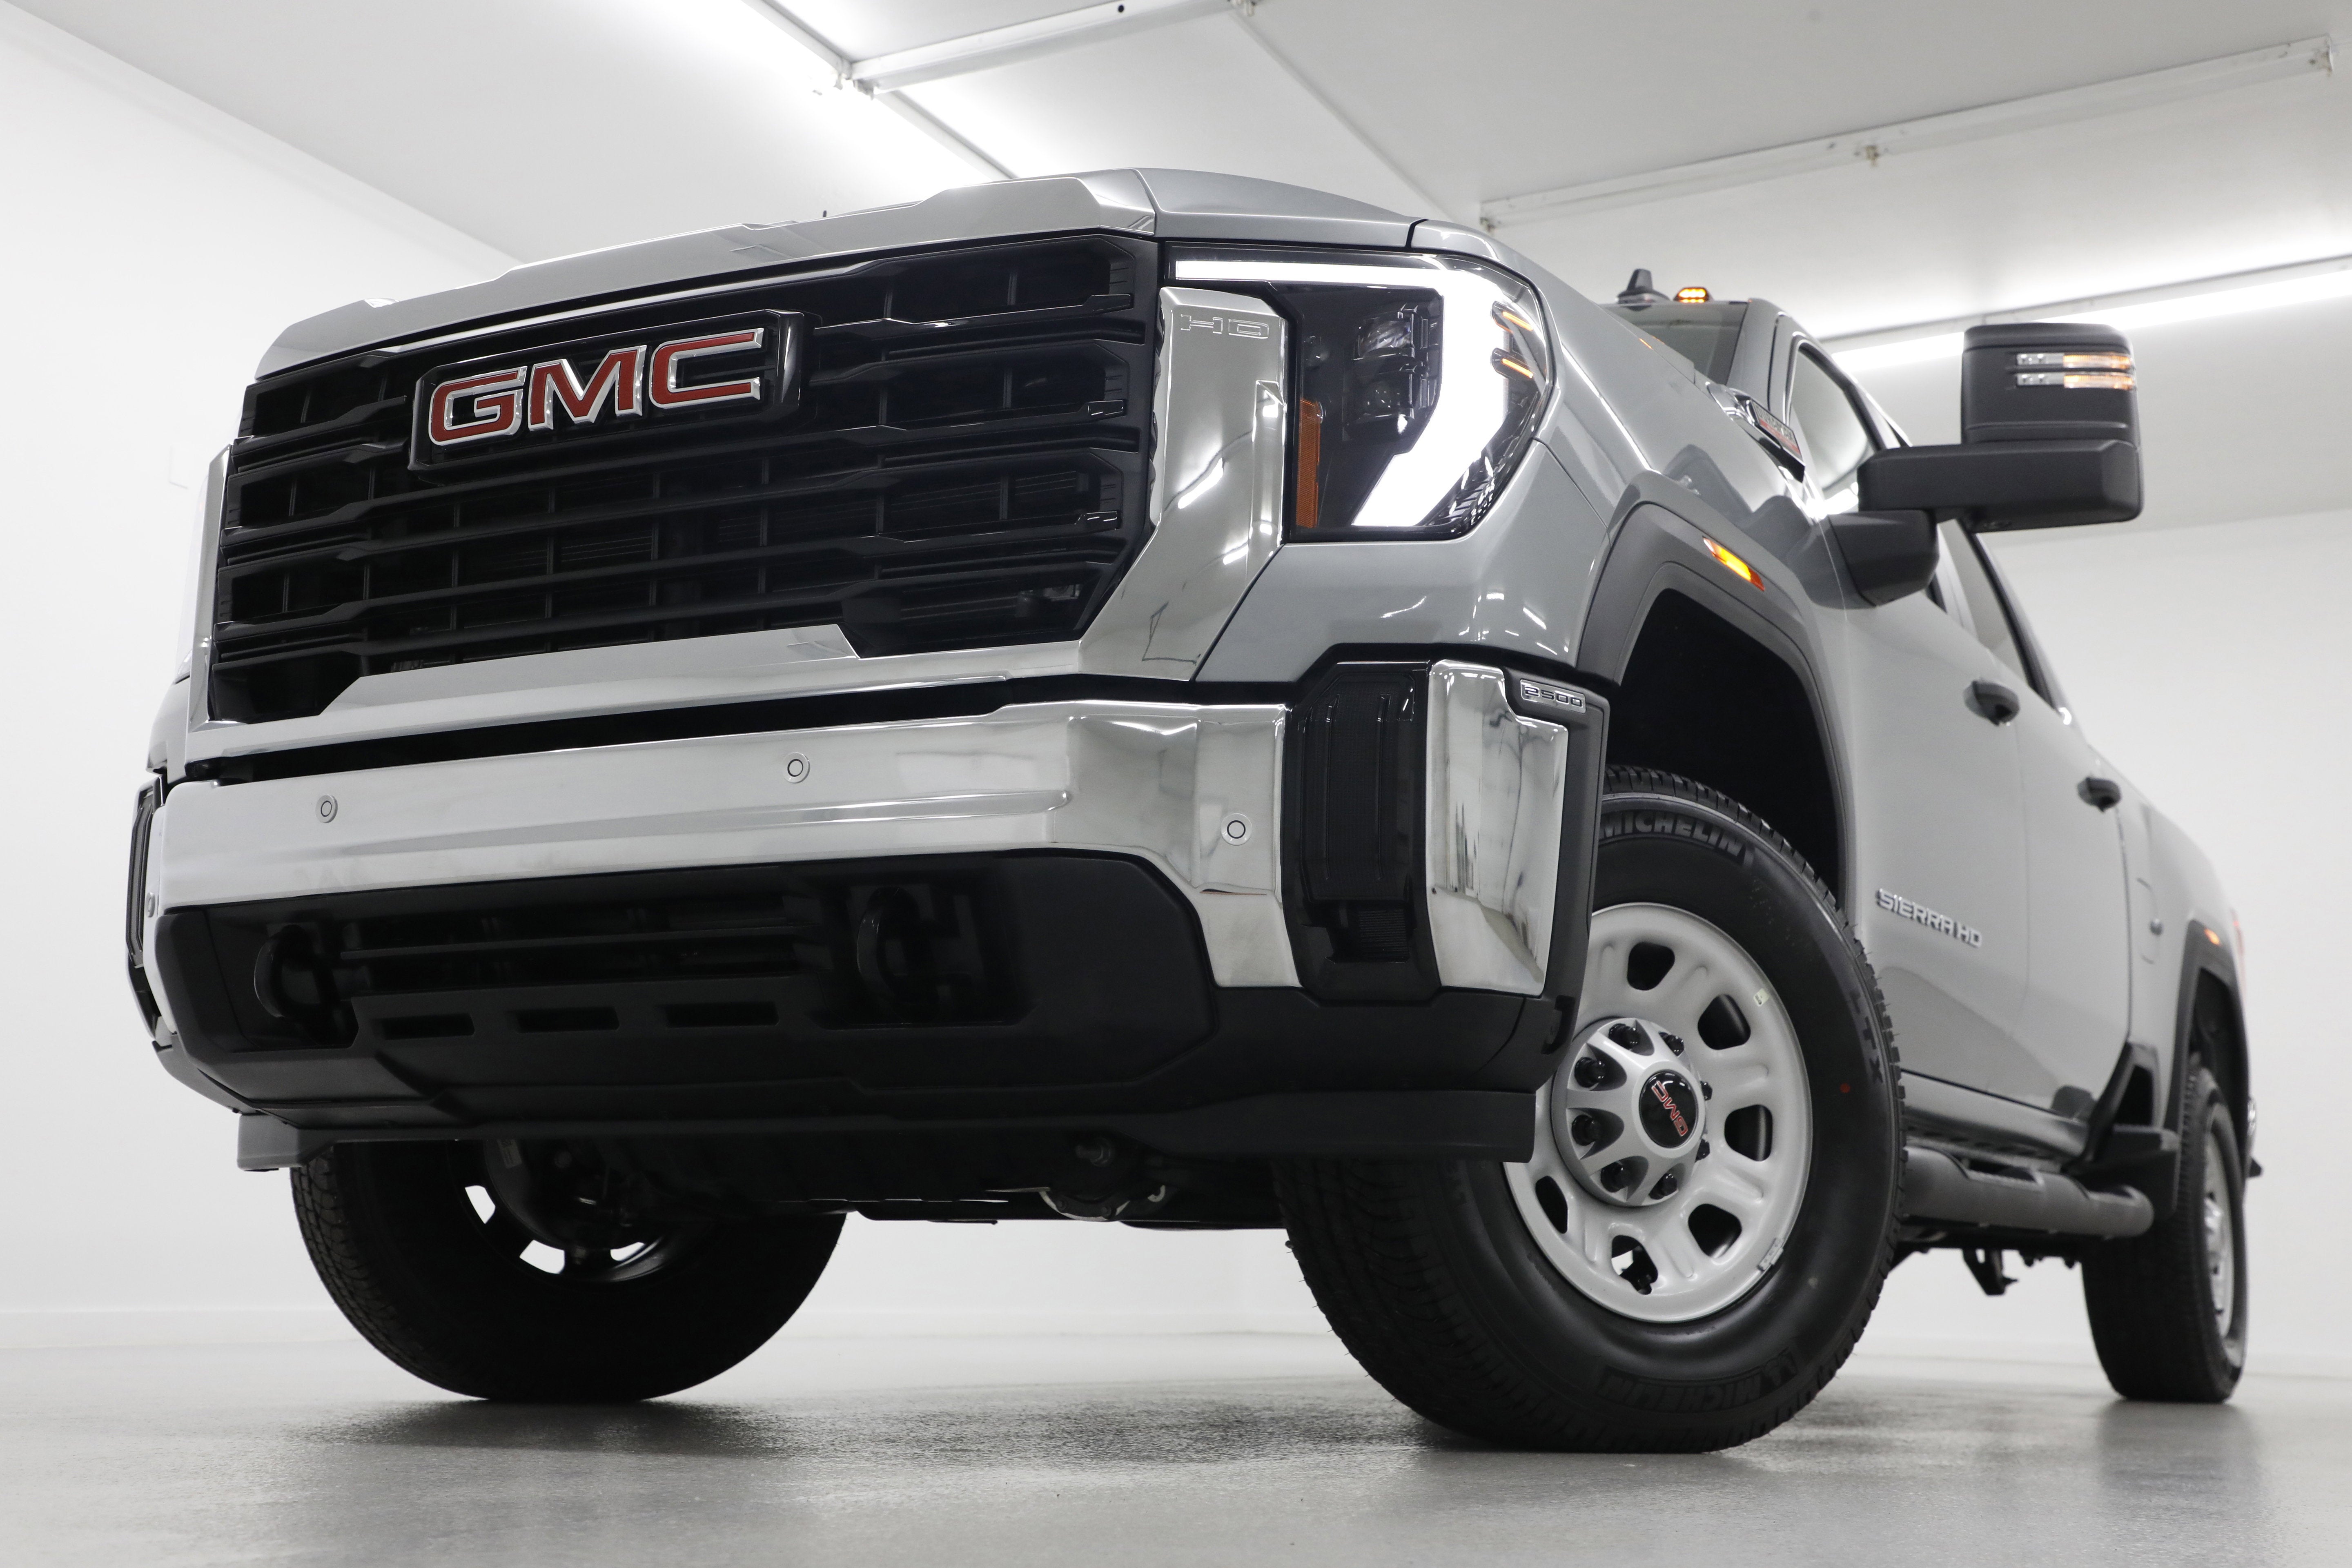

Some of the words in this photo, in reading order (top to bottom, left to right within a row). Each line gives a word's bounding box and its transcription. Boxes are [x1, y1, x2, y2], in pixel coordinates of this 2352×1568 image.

[1180, 314, 1270, 339] HD
[429, 327, 764, 446] GMC
[1524, 685, 1583, 708] 2500
[1598, 811, 1746, 857] MICHELIN
[1876, 888, 1954, 936] SIERRA
[1957, 921, 1982, 949] HD
[1651, 1080, 1688, 1137] GMC
